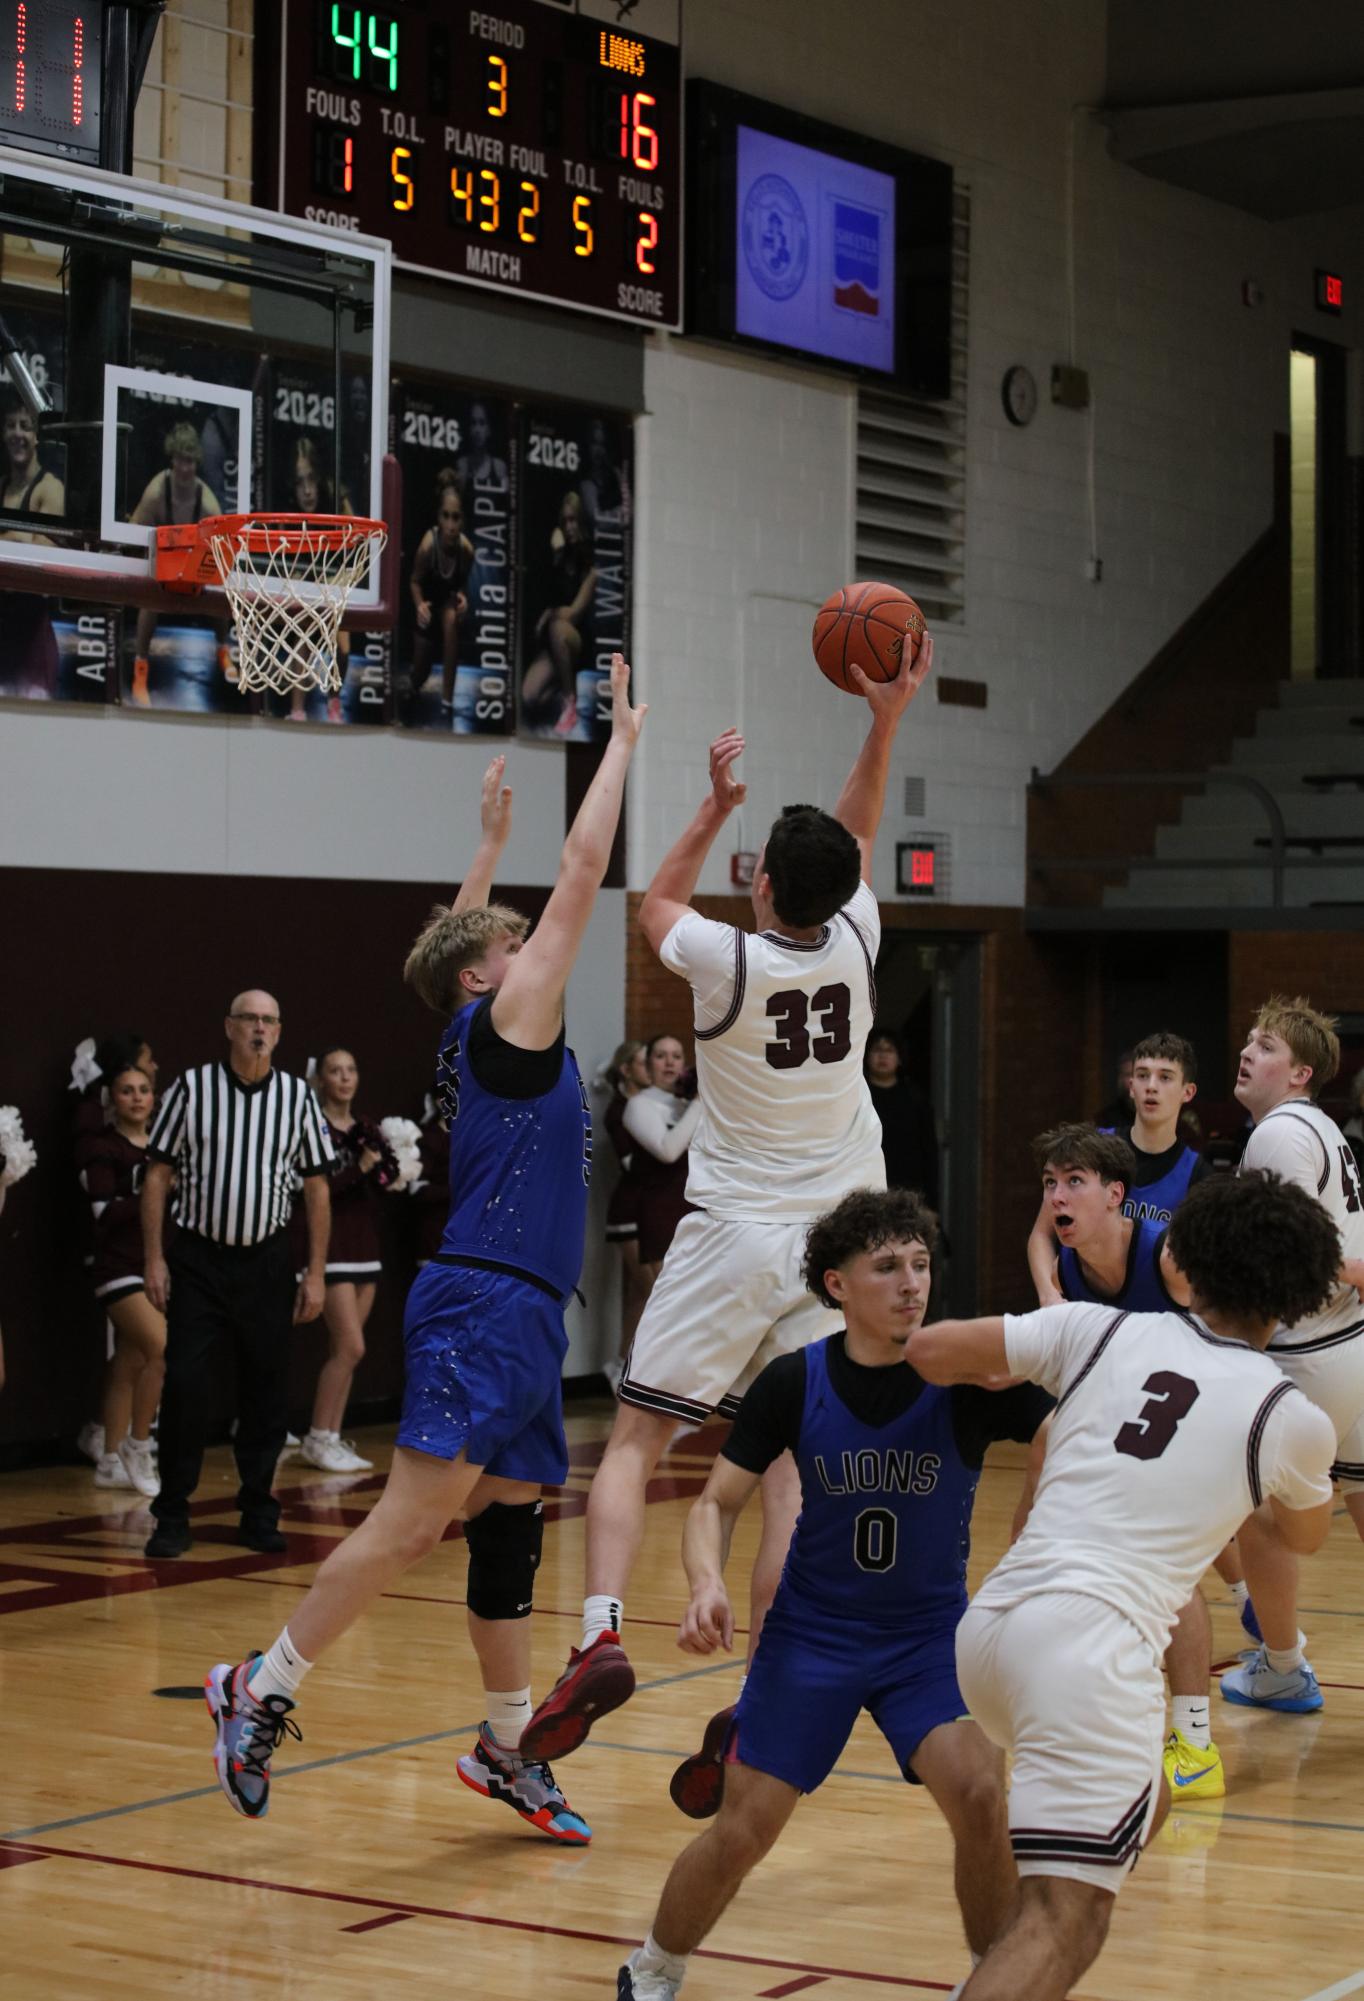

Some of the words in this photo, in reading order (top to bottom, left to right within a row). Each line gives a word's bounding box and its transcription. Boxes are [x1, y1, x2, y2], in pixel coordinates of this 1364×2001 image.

[331, 3, 398, 91] 44
[470, 11, 525, 49] PERIOD
[306, 87, 361, 127] FOULS
[487, 55, 508, 117] 3
[381, 108, 425, 144] T.O.L.
[444, 126, 504, 166] PLAYER
[510, 147, 548, 178] FOUL
[621, 93, 658, 170] 16
[344, 138, 352, 192] 1
[391, 147, 414, 211] 5
[563, 160, 603, 193] T.O.L.
[304, 206, 360, 233] SCORE
[451, 167, 500, 232] 43
[518, 182, 540, 243] 2
[618, 176, 664, 209] FOULS
[573, 196, 593, 256] 5
[636, 212, 658, 273] 2
[466, 245, 522, 282] MATCH
[617, 284, 663, 316] SCORE
[274, 387, 335, 430] 2026
[401, 411, 462, 452] 2026
[527, 433, 581, 472] 2026
[474, 473, 507, 566] CAPE
[76, 614, 106, 683] ABR
[475, 584, 507, 720] Sophia
[765, 982, 851, 1069] 33
[1121, 1198, 1171, 1223] ONS
[1113, 1370, 1200, 1460] 3
[814, 1448, 941, 1495] LIONS
[853, 1507, 898, 1573] 0
